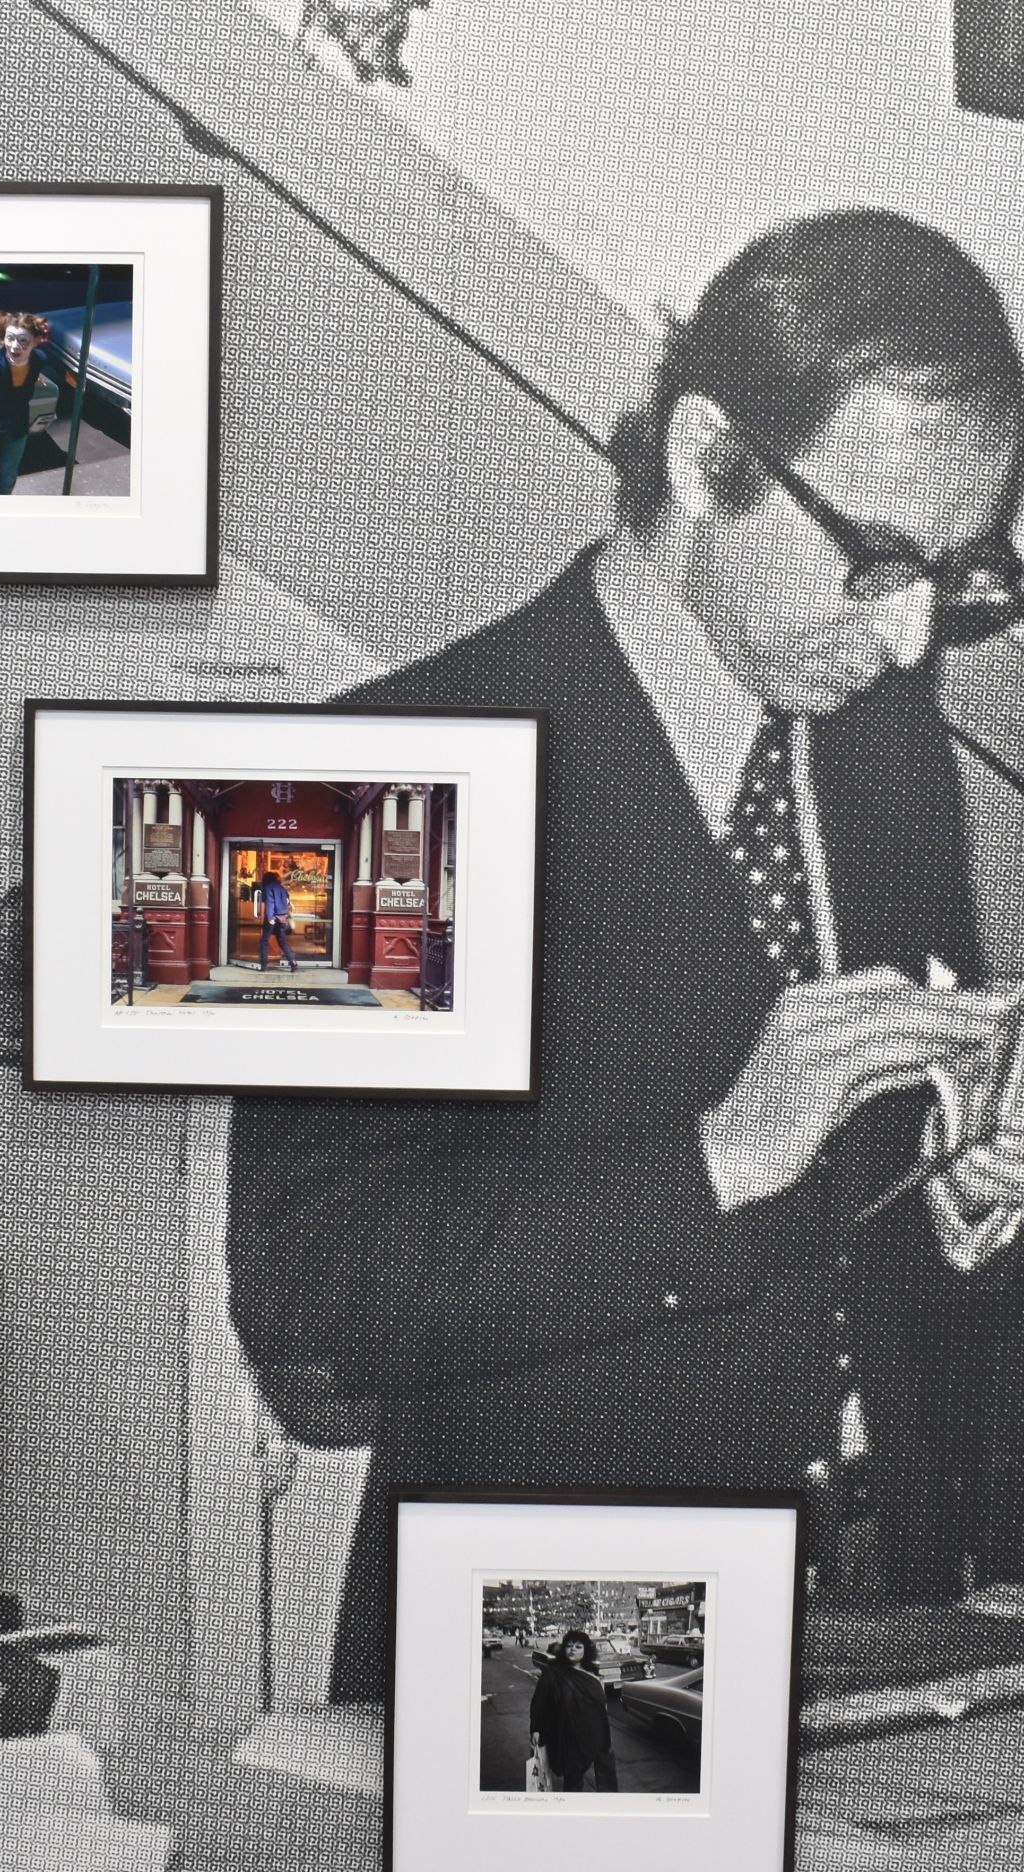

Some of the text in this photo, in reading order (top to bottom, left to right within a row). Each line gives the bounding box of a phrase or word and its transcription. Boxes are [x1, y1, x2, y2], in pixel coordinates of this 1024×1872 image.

[267, 818, 298, 830] 222
[135, 891, 182, 902] CHELSEA
[380, 897, 425, 908] CHELSEA
